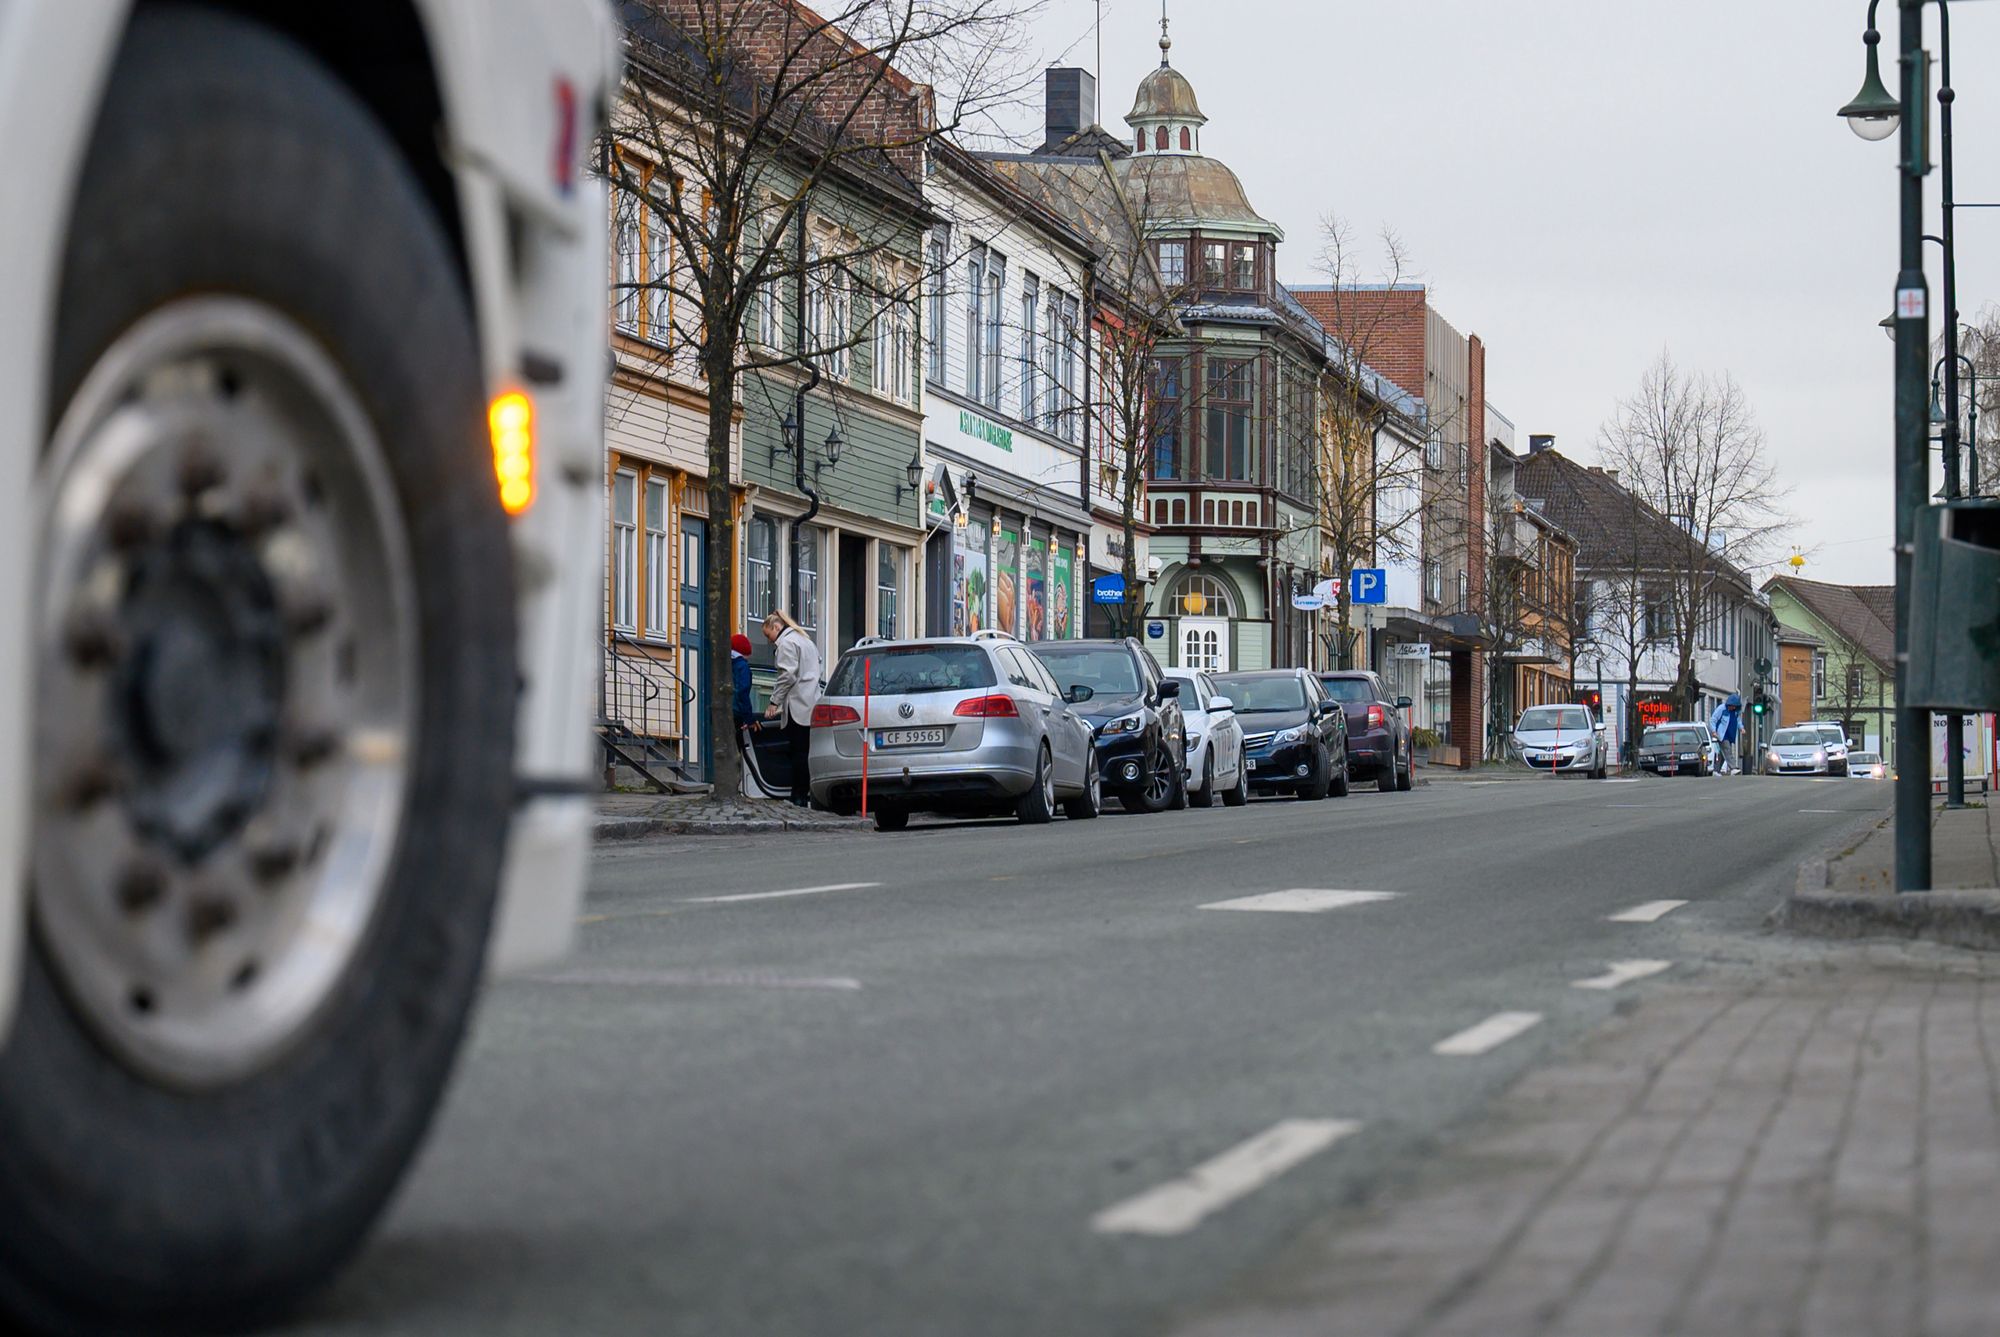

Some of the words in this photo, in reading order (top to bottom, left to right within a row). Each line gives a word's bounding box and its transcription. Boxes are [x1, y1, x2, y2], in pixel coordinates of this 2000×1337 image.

[1360, 573, 1377, 599] P
[887, 733, 900, 743] CF
[906, 730, 941, 742] 59565
